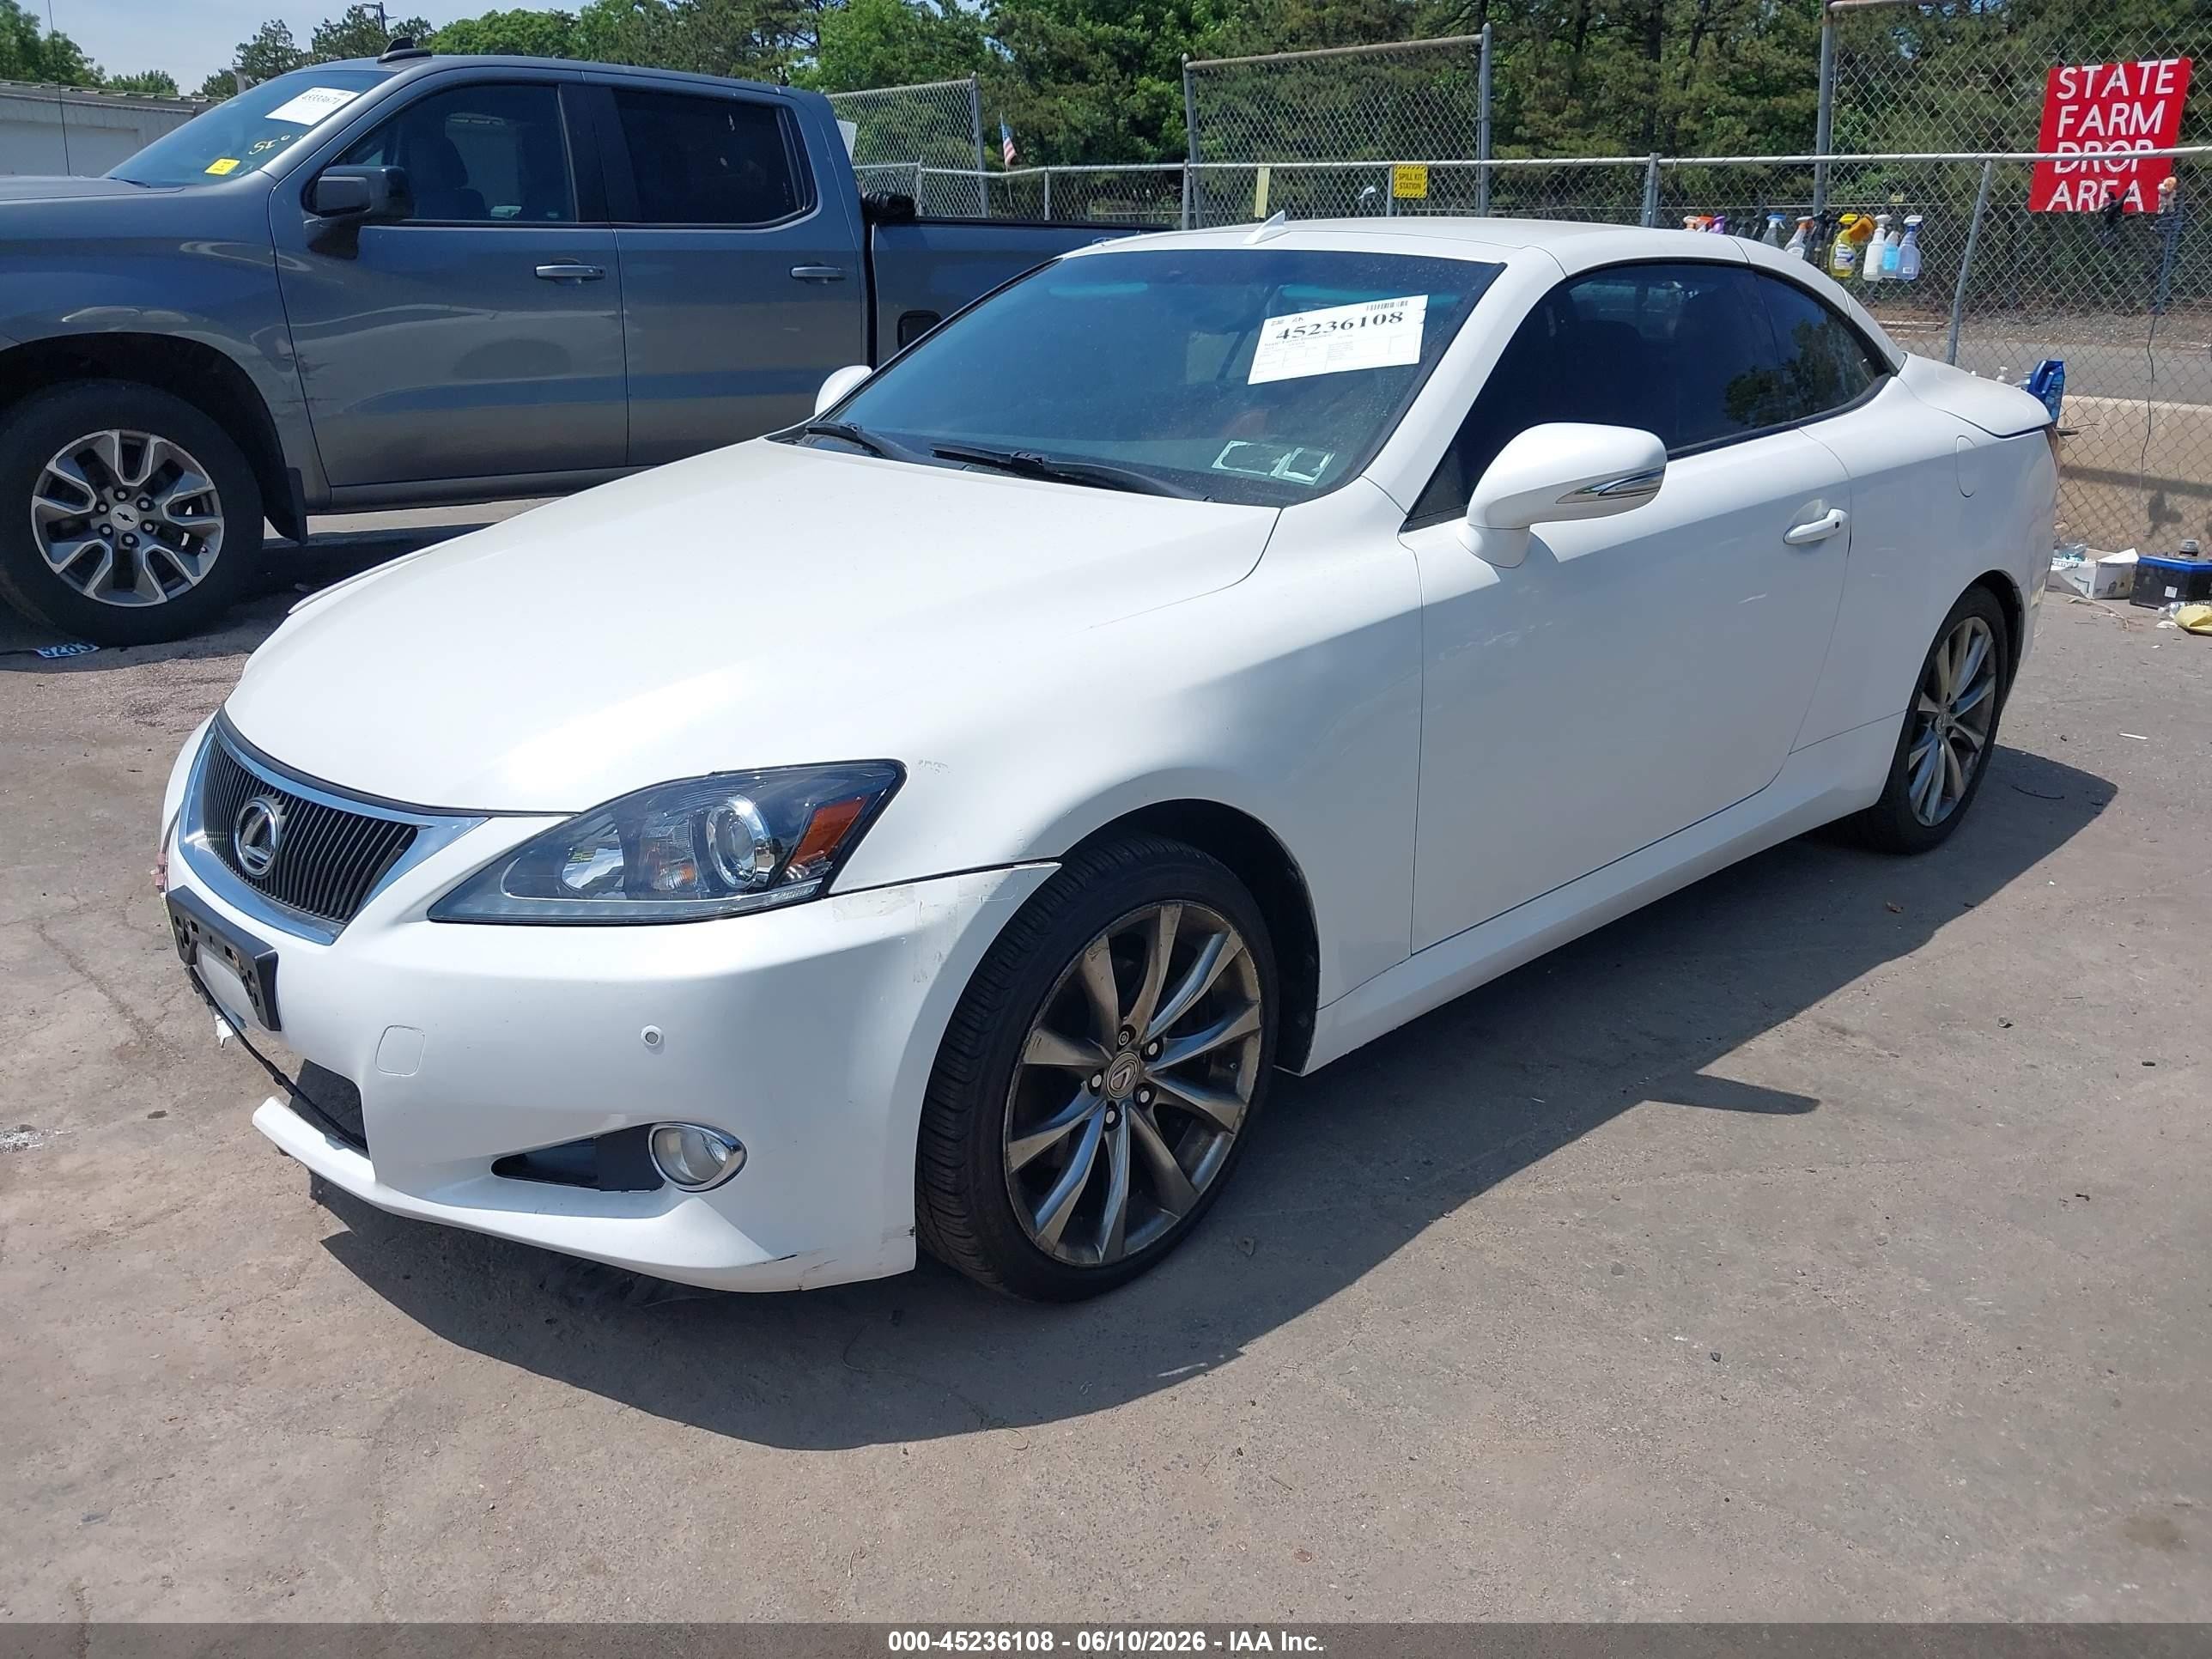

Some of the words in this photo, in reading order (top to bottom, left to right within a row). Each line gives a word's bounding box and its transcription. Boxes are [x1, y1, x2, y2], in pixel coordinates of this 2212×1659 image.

[2057, 59, 2179, 99] STATE
[2057, 100, 2165, 137] FARM
[2055, 140, 2153, 173] DROP
[2046, 180, 2144, 211] AREA
[1276, 312, 1403, 339] 45236108
